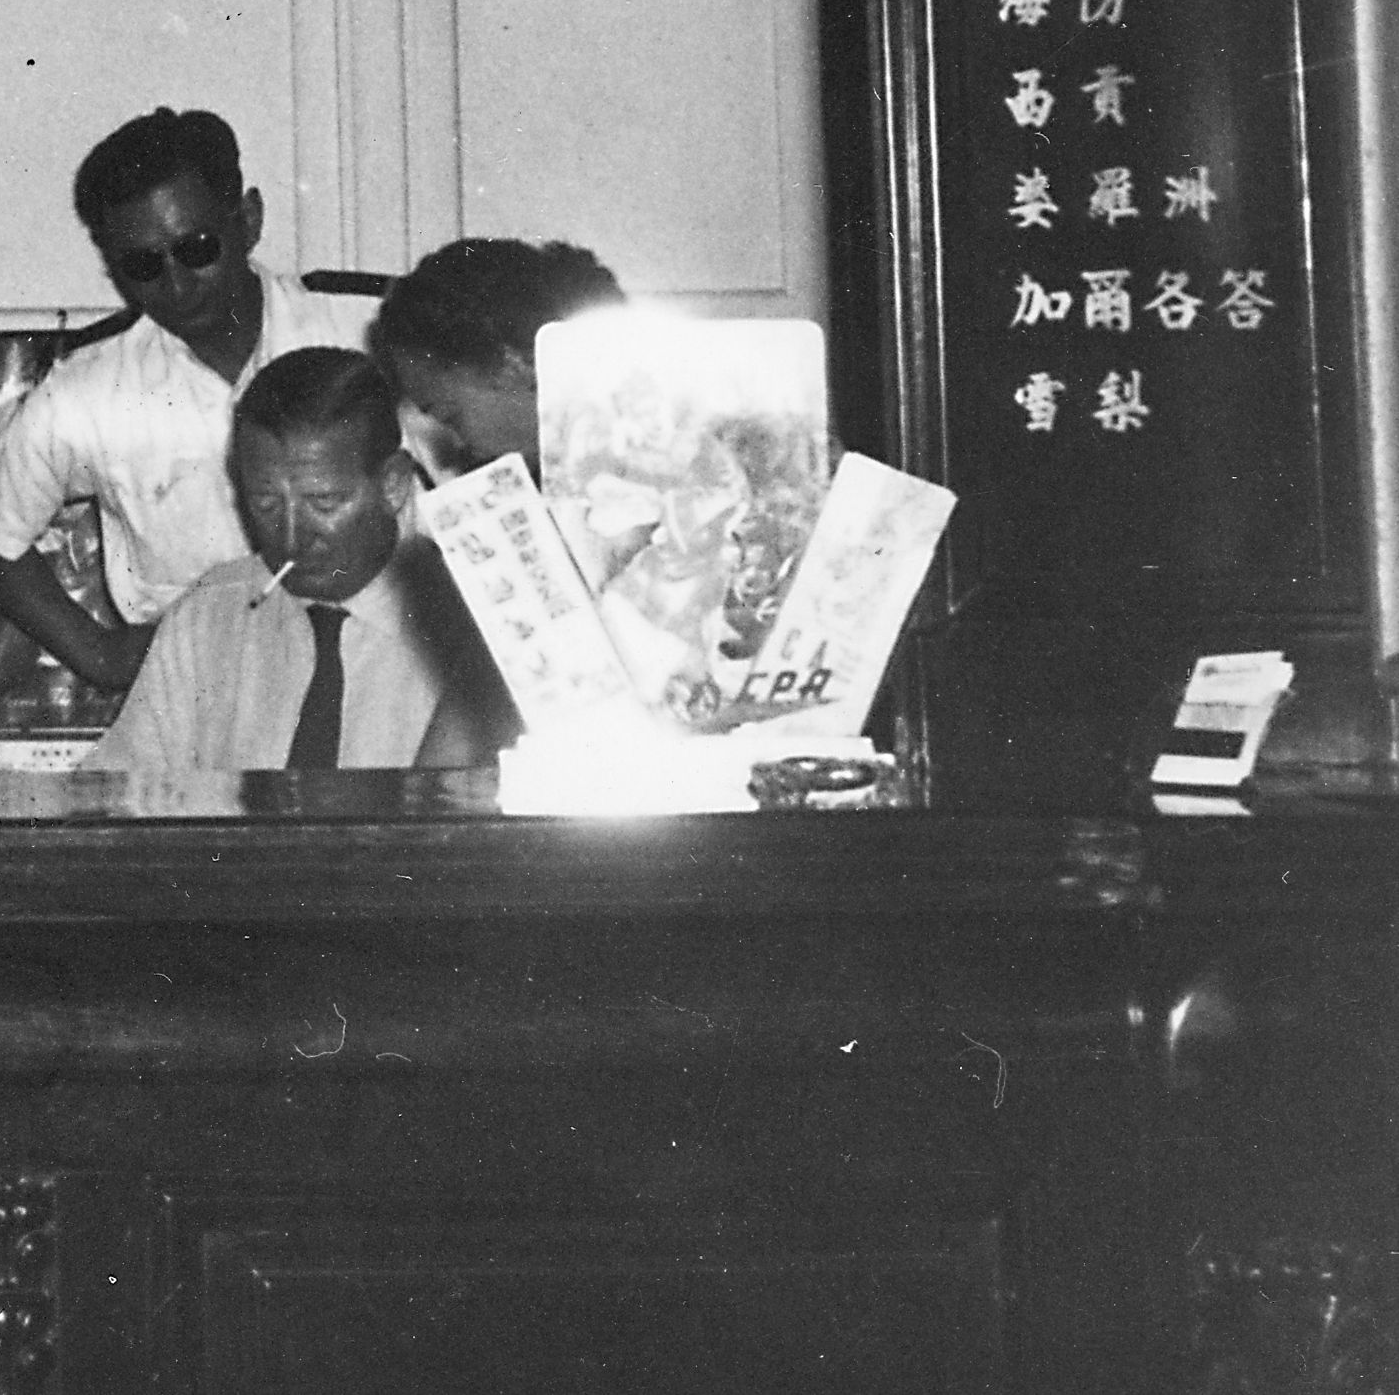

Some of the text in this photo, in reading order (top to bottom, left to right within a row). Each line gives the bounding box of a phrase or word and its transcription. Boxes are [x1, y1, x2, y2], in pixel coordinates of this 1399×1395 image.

[1004, 66, 1135, 127] 西貢
[1008, 165, 1221, 229] 婆羅洲
[1014, 370, 1151, 432] 雪梨
